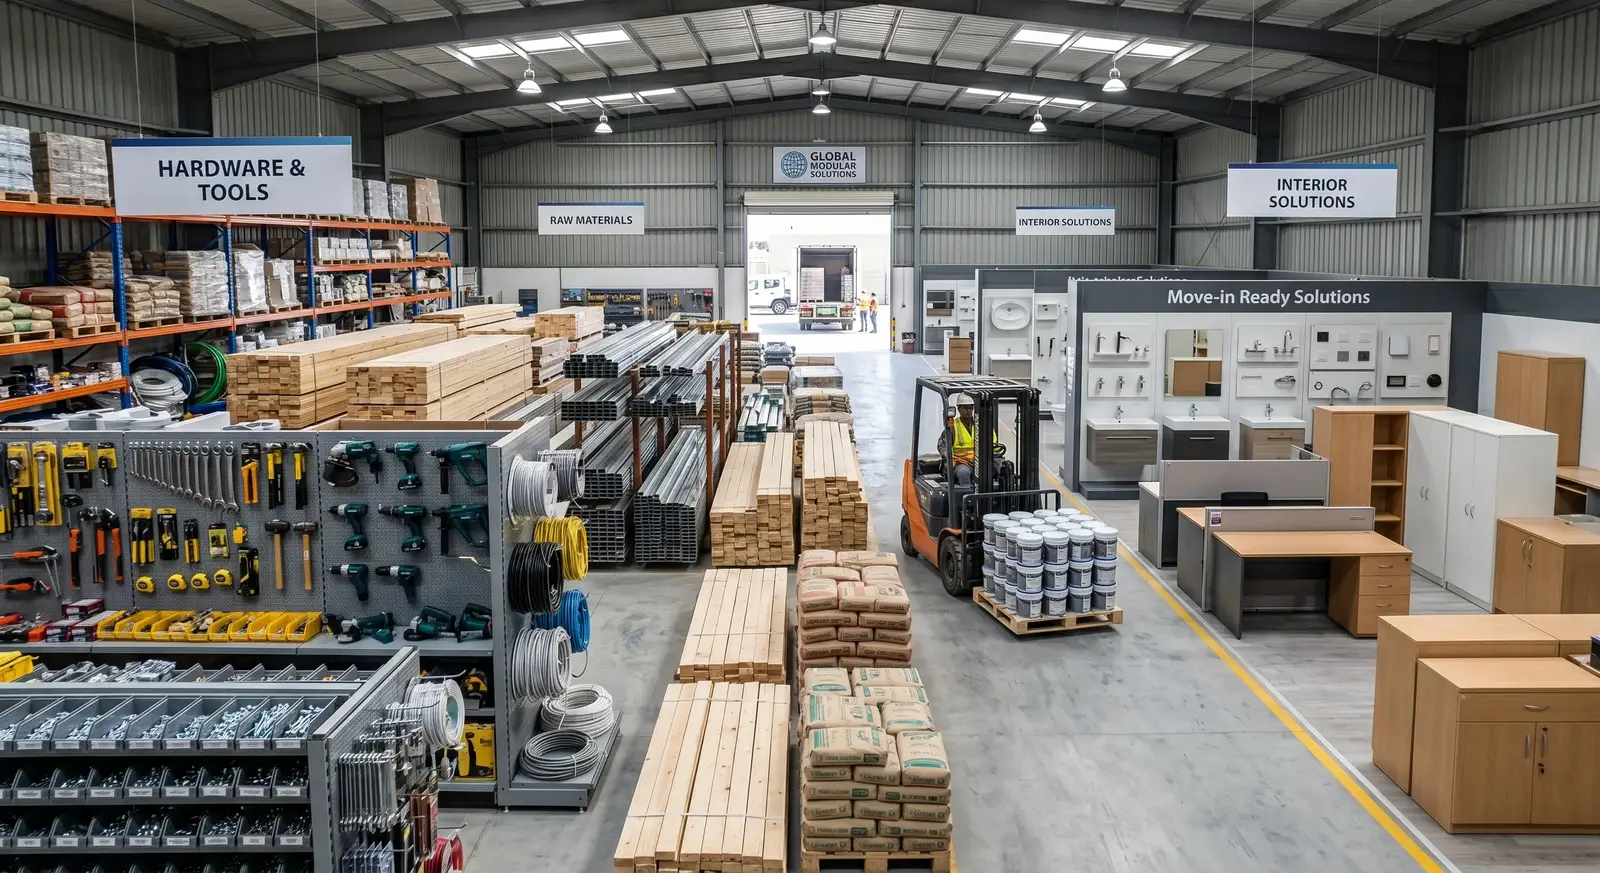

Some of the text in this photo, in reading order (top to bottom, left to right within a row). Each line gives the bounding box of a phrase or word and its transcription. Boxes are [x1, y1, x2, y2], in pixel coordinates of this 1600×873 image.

[811, 151, 857, 162] GLOBAL
[158, 158, 306, 177] HARDWARE &
[810, 162, 857, 170] MODULAR
[810, 170, 857, 179] SOLUTIONS
[1277, 178, 1348, 192] INTERIOR
[197, 183, 269, 202] TOOLS
[1269, 195, 1355, 209] SOLUTIONS
[550, 215, 633, 225] RAW MATERIALS
[1018, 218, 1112, 227] INTERIOR SOLUTIONS
[1167, 288, 1371, 308] Move-in Ready Solutions
